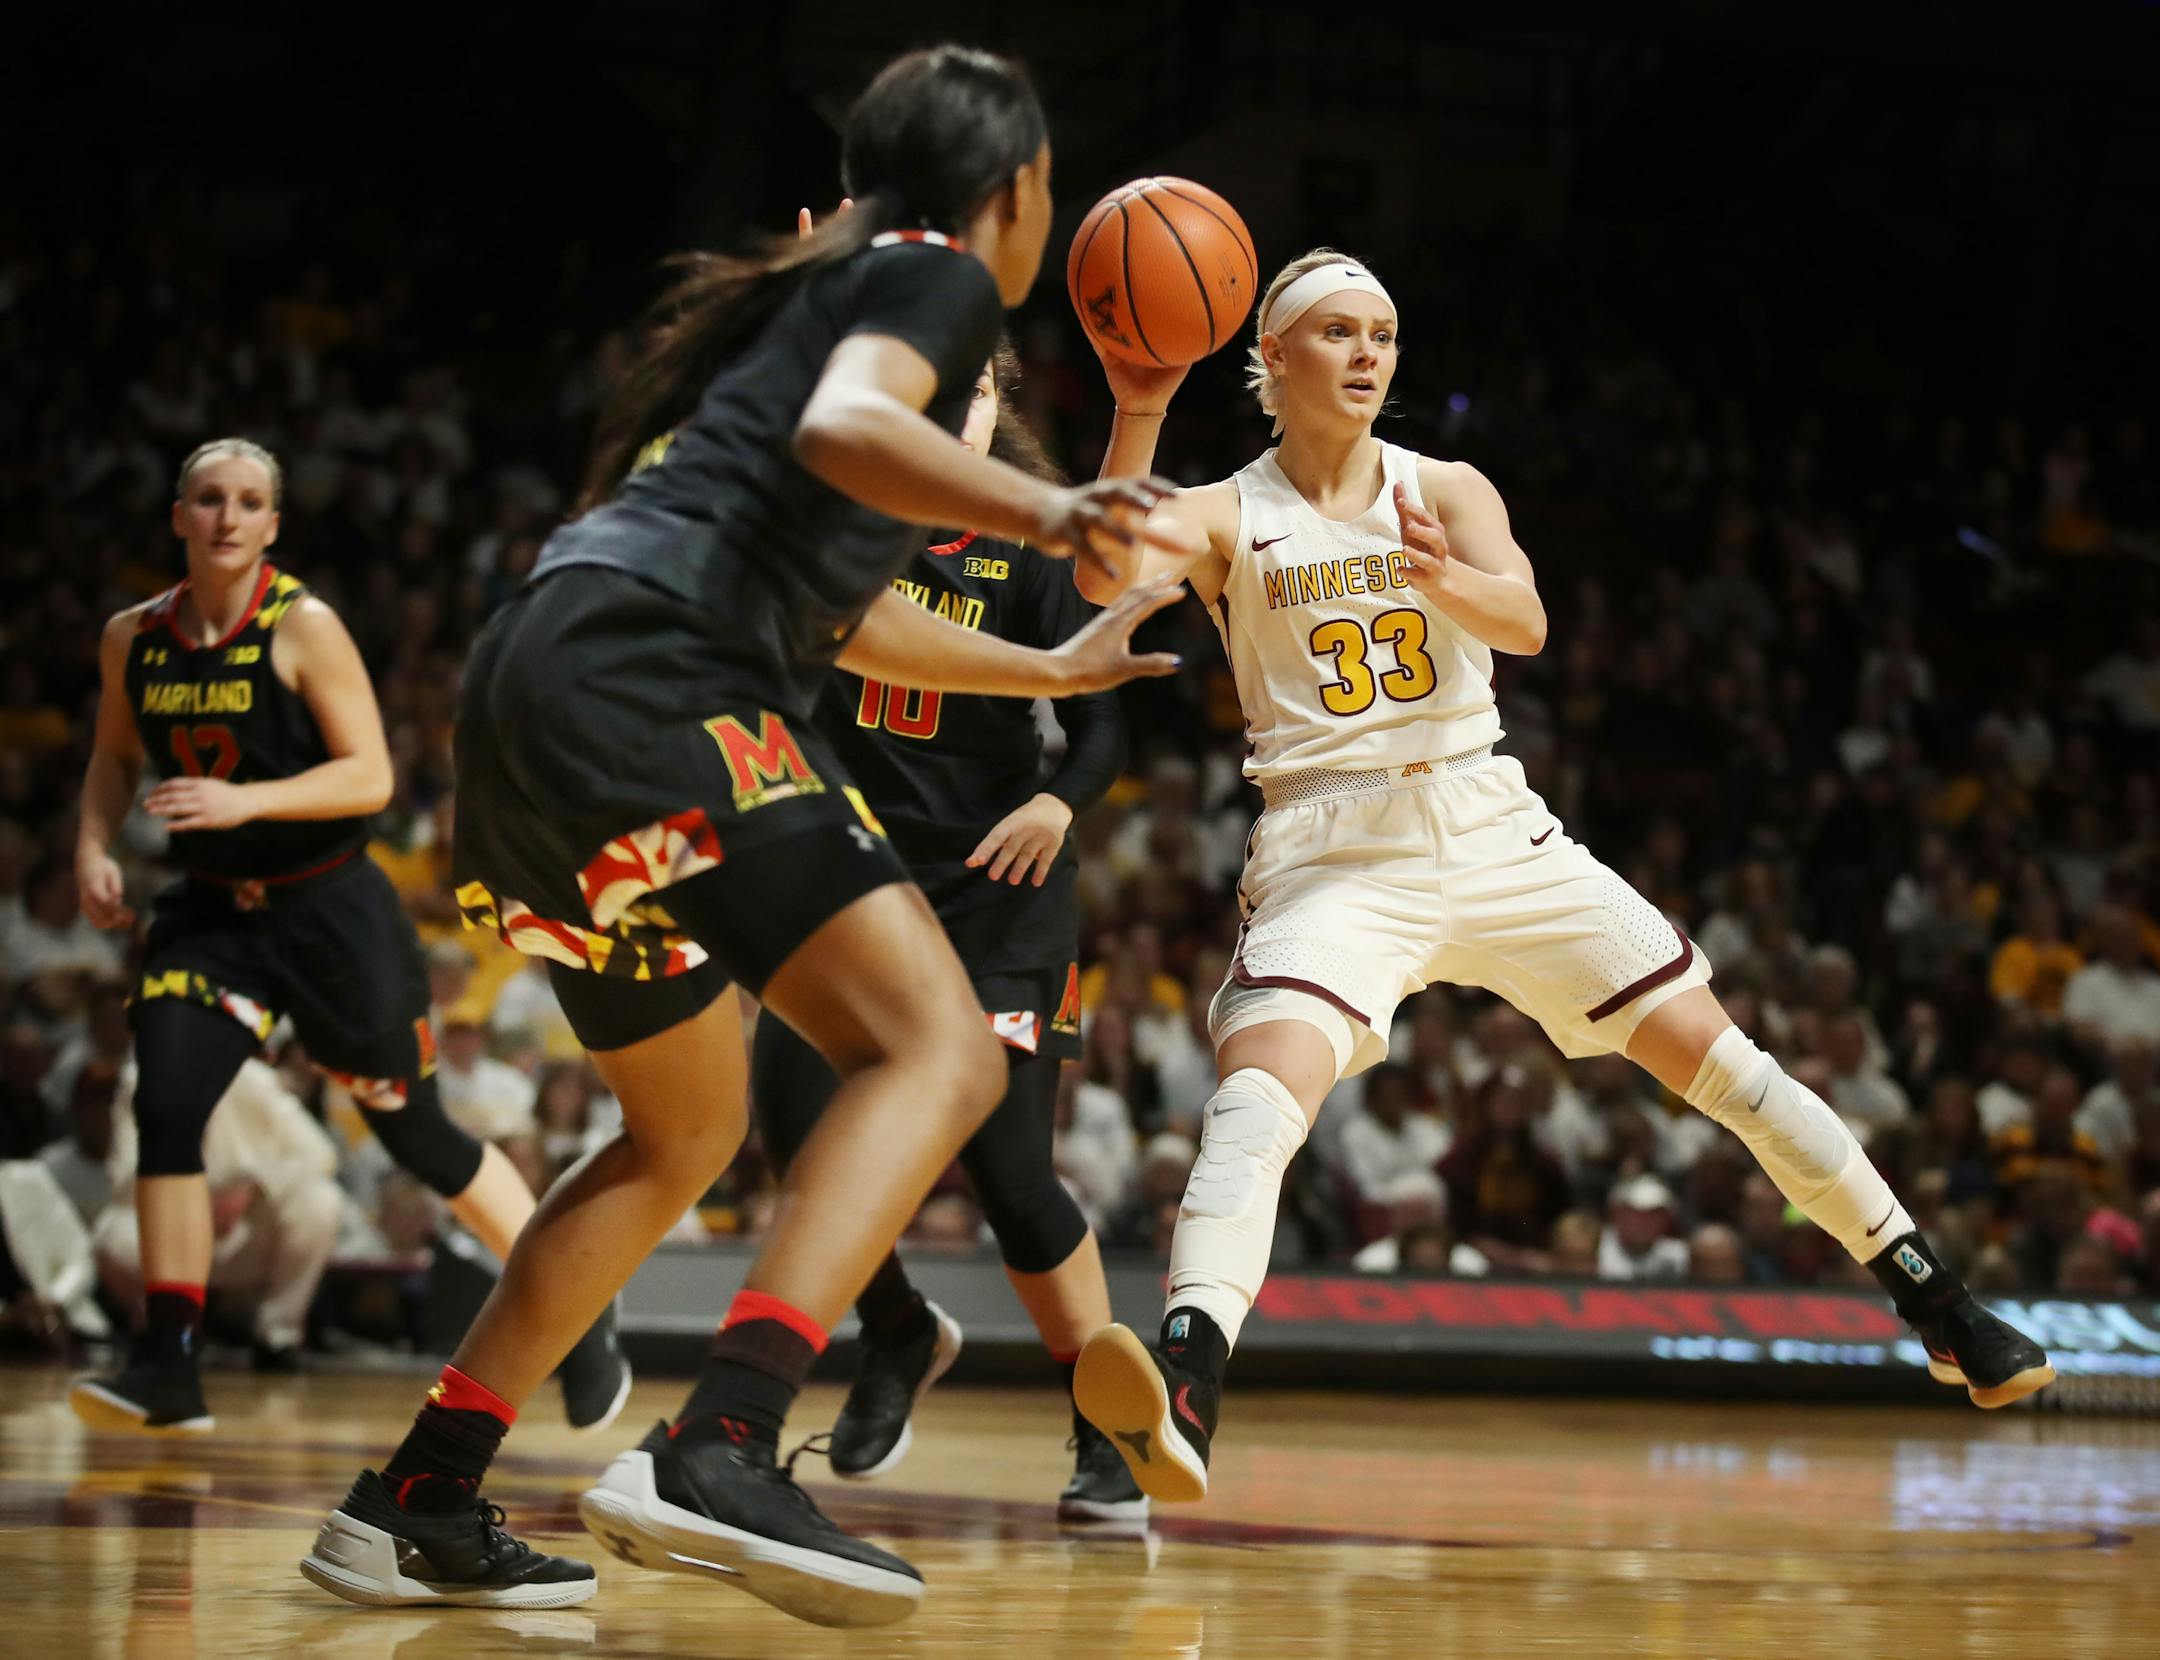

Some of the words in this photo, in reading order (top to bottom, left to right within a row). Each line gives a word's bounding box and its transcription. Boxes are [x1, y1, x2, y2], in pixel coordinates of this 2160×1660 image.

[143, 680, 252, 714] MARYLAND
[1309, 608, 1437, 717] 33
[703, 710, 826, 813] M
